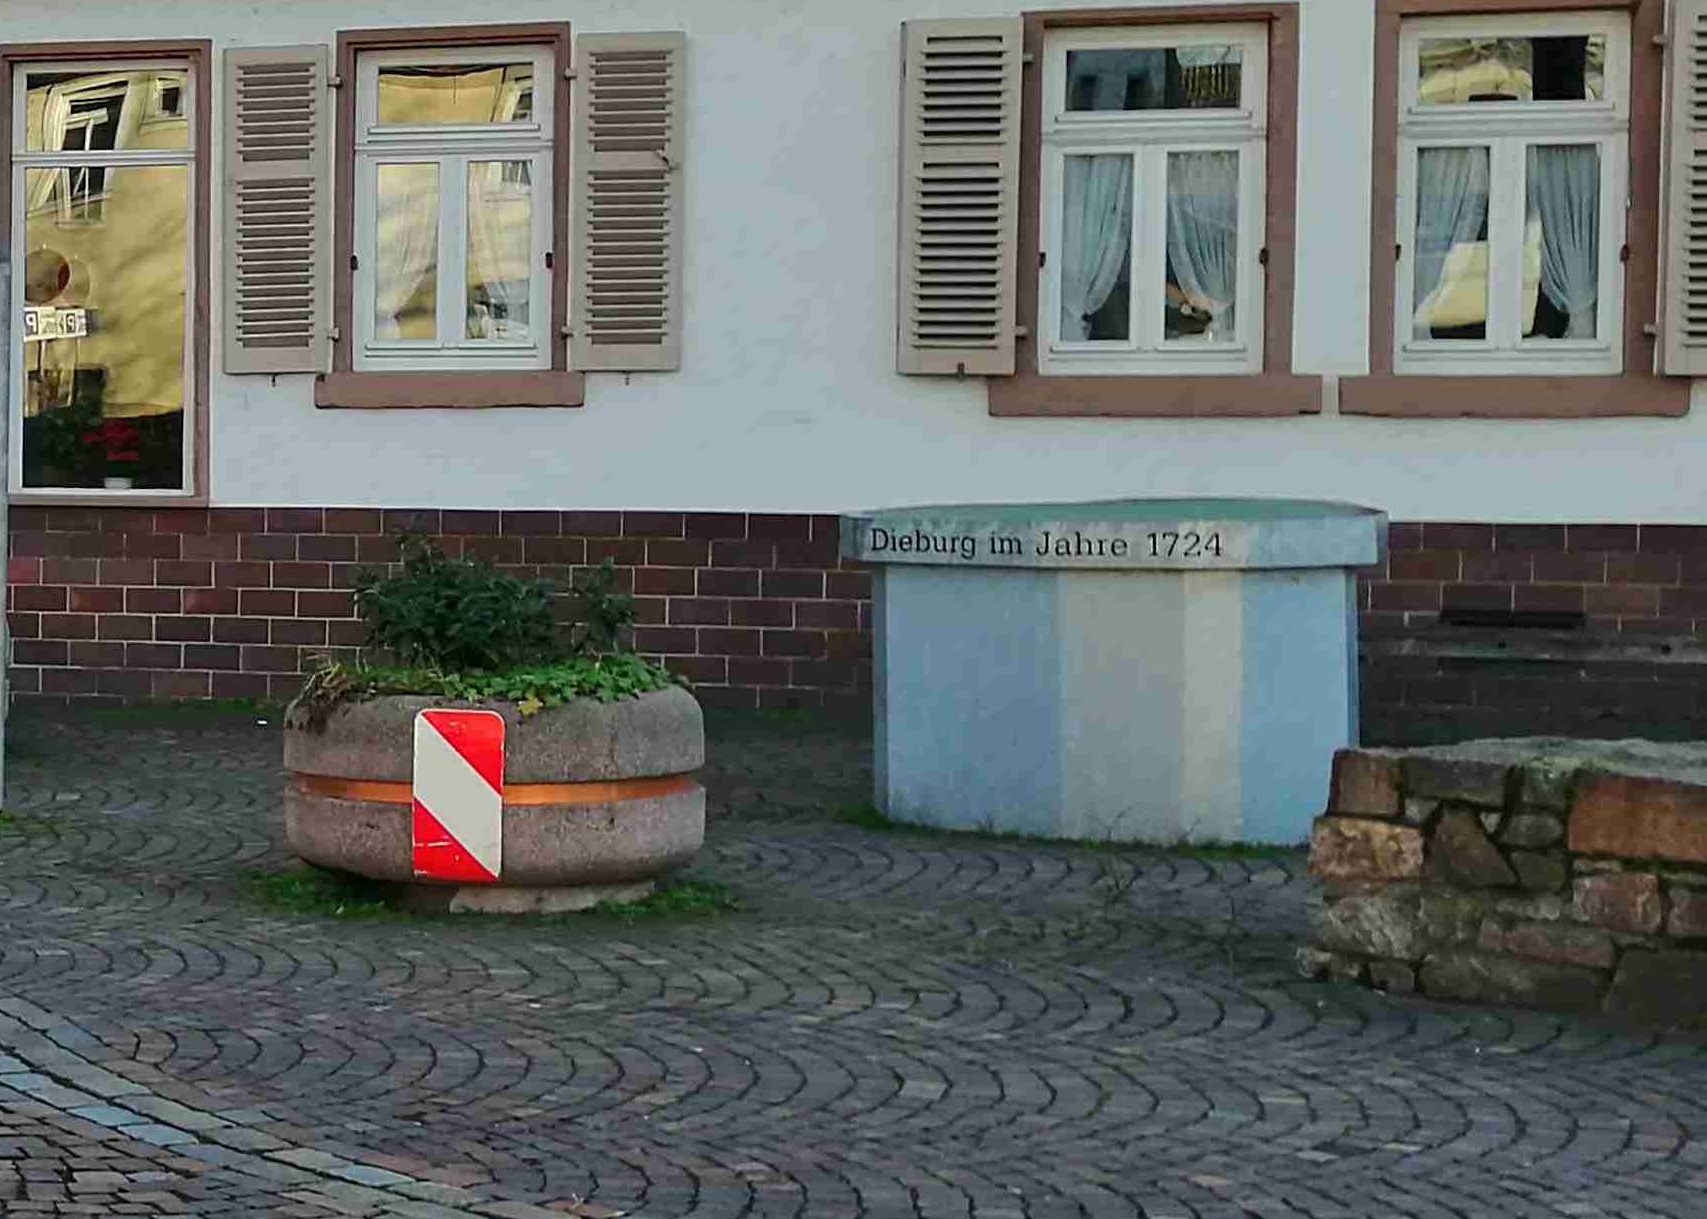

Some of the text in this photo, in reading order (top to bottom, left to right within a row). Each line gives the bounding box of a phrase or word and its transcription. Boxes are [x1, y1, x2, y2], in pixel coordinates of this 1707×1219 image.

[870, 528, 1223, 558] Dieburg im Jahre 1724
